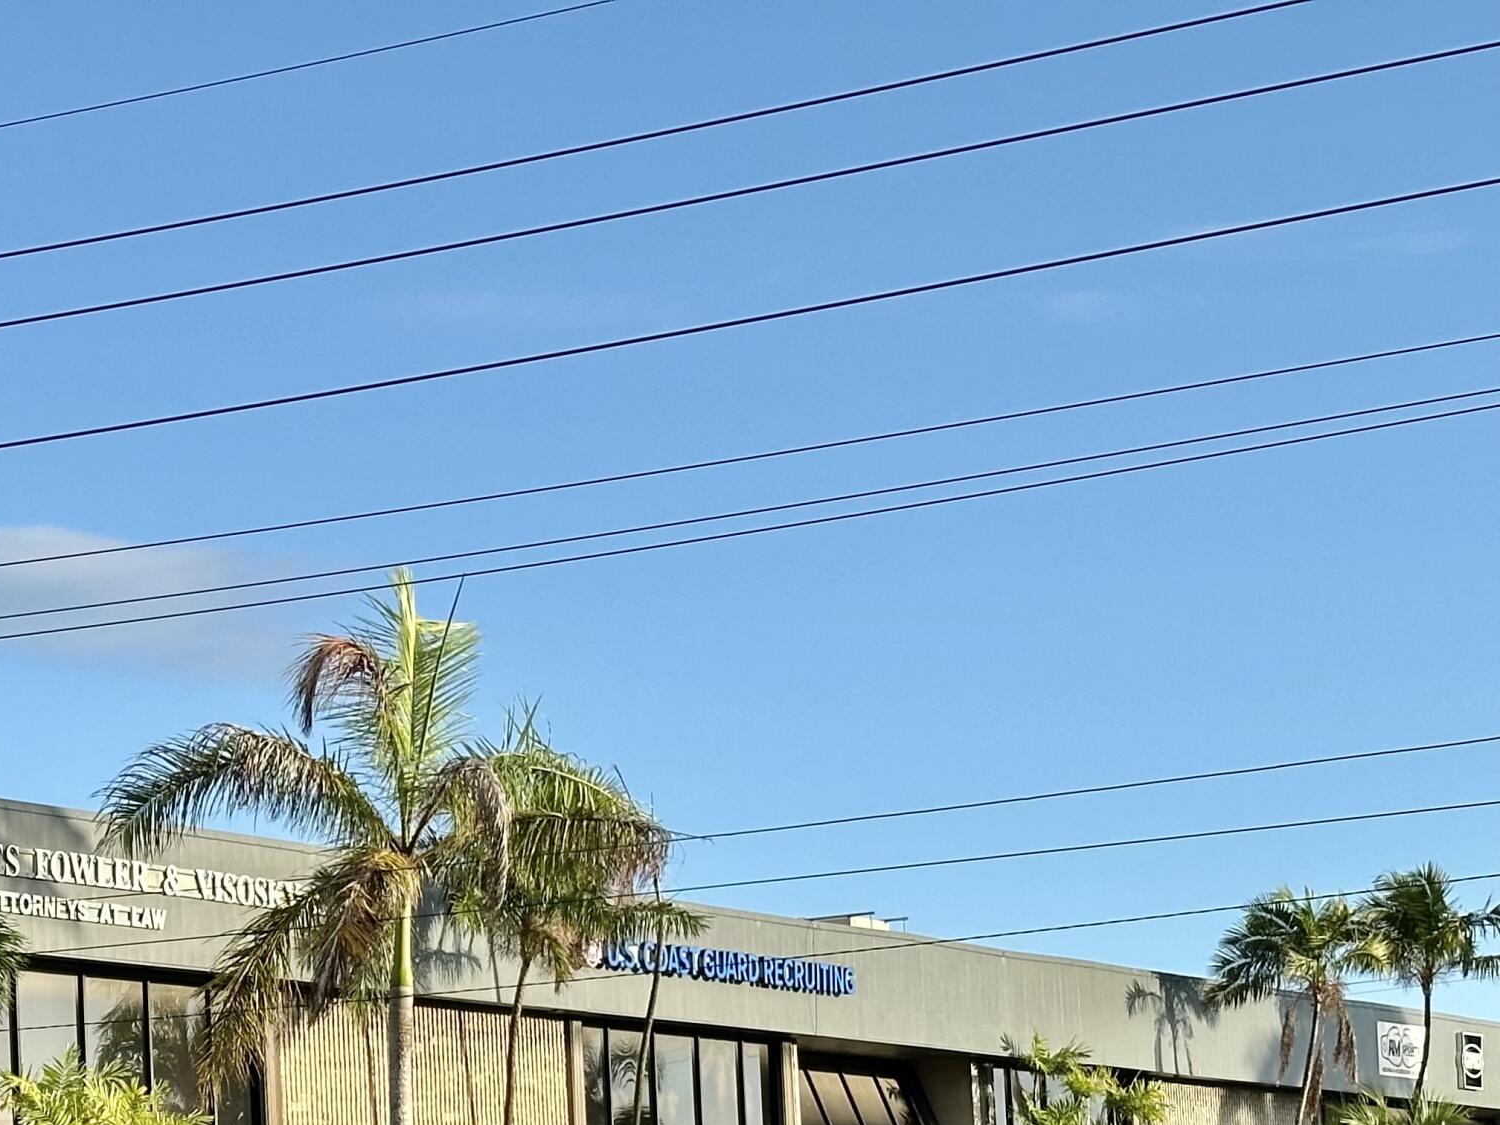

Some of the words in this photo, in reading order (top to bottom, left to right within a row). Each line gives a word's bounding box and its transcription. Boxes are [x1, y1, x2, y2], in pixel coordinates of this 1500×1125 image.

[35, 848, 150, 893] FOWLER
[162, 864, 180, 897] &
[100, 902, 123, 925] AT
[132, 906, 167, 930] LAW
[607, 939, 640, 969] U.S.
[703, 949, 759, 982] GUARD
[763, 956, 855, 994] RECRUITING
